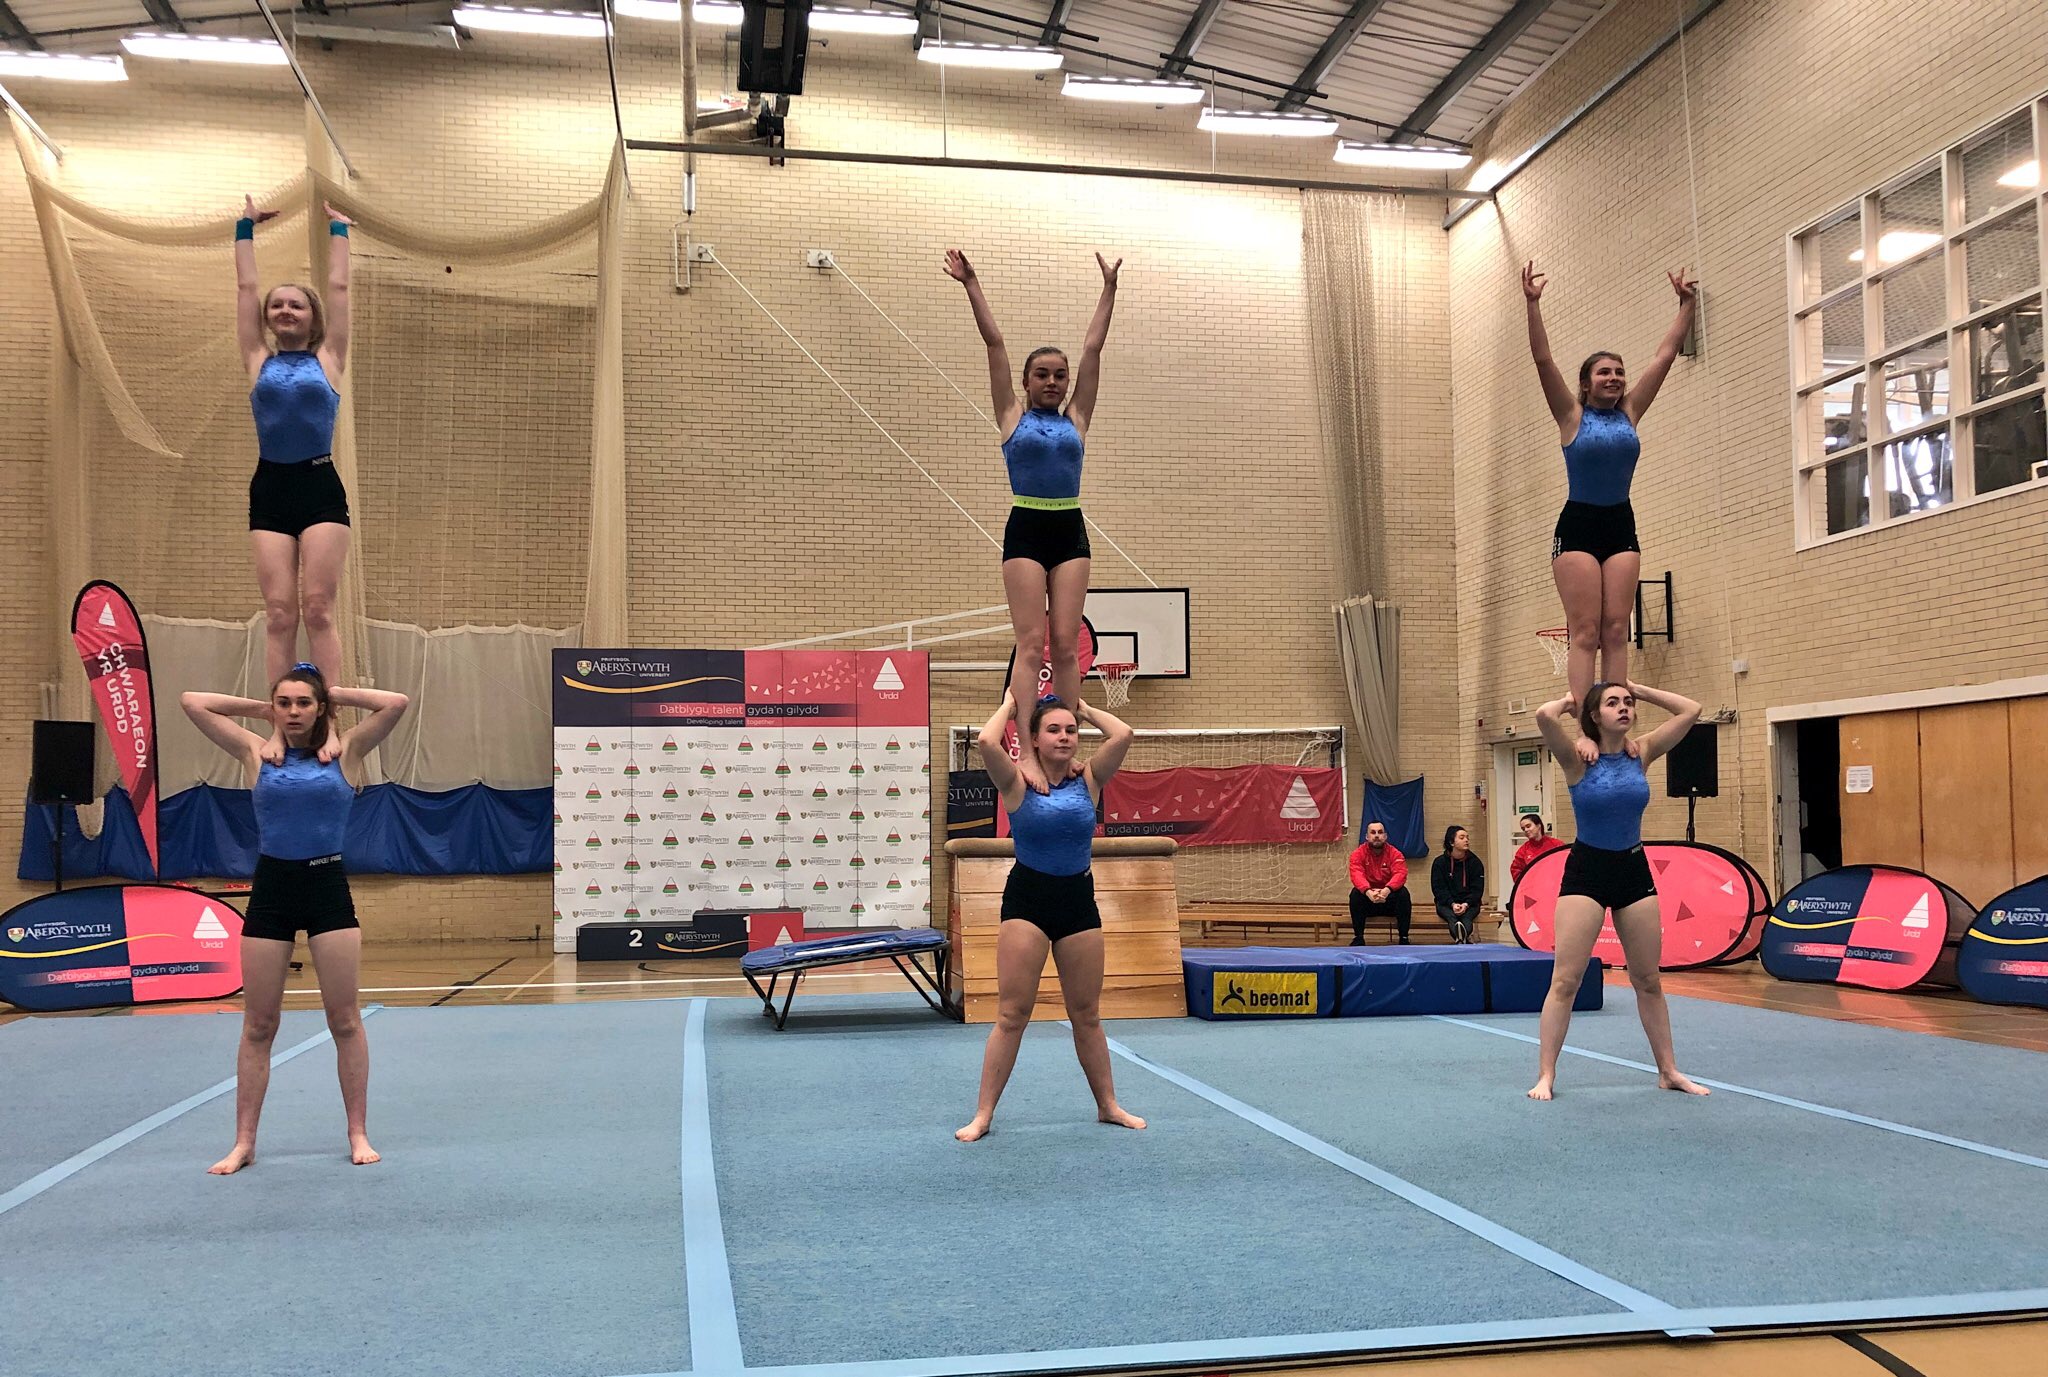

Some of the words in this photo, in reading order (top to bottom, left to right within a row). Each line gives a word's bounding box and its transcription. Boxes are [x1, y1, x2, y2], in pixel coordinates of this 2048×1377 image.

[592, 660, 670, 675] ABERYSTWYTH
[96, 648, 113, 676] YR
[106, 678, 128, 734] URDD
[879, 692, 899, 700] Urdd
[110, 642, 147, 768] CHWARAEON
[660, 704, 709, 715] Datblygu
[712, 704, 743, 714] talent
[747, 705, 783, 716] gyda'n
[786, 705, 819, 716] gilydd
[686, 718, 723, 726] Developing
[1107, 824, 1142, 835] gyda'n
[1144, 823, 1174, 834] gilydd
[1288, 822, 1314, 832] Urdd
[1797, 900, 1851, 912] ABERYSTWYTH
[25, 924, 111, 940] ABERYSTWYTH
[200, 940, 224, 949] Urdd
[629, 929, 643, 948] 2
[132, 965, 166, 977] gyda'n
[168, 964, 199, 975] gilydd
[1250, 989, 1310, 1006] beemat
